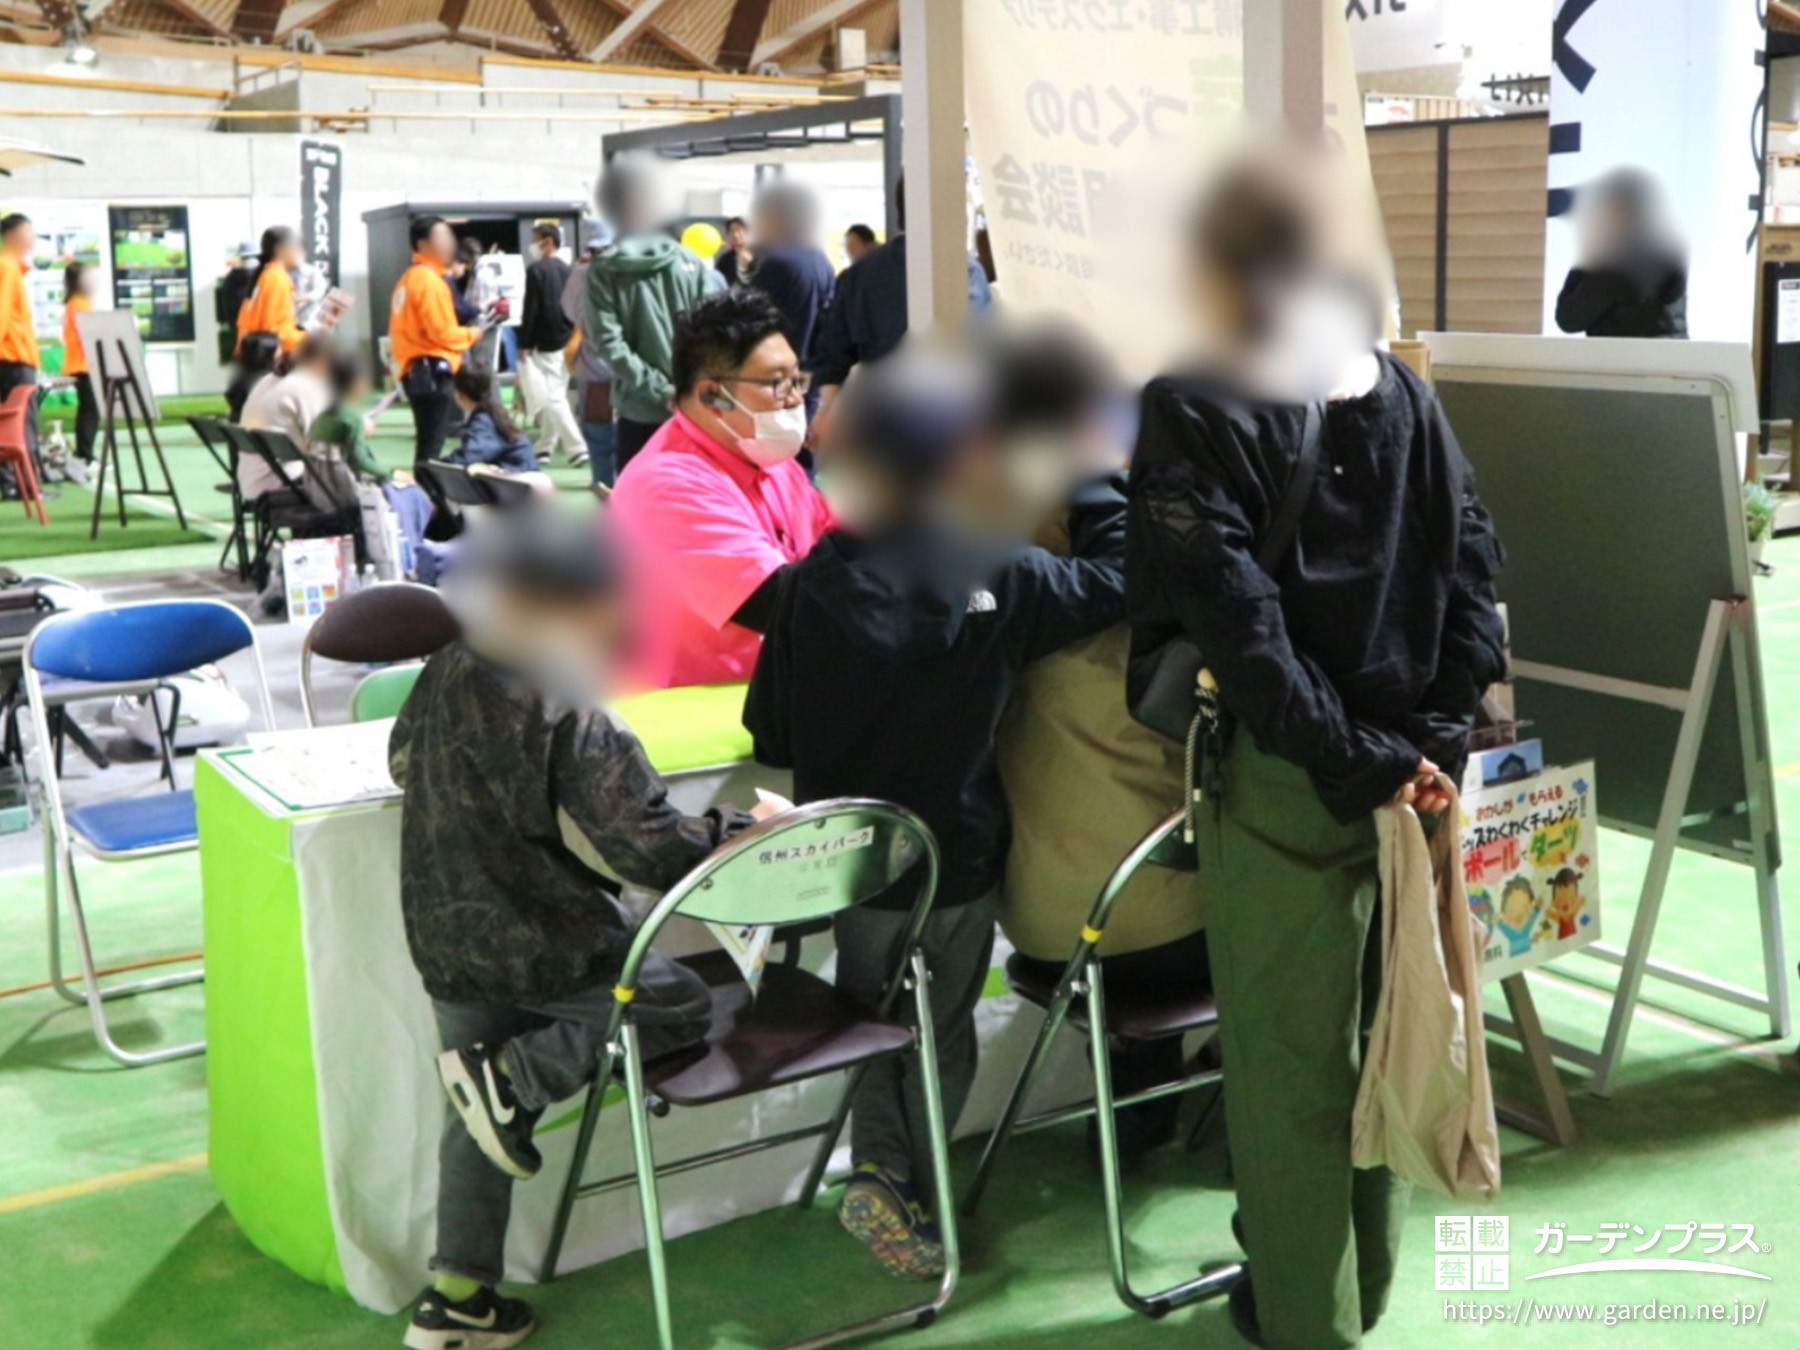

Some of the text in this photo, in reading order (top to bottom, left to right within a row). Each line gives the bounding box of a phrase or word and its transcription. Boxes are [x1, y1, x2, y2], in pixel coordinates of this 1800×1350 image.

[759, 831, 870, 864] 信州スカイパーク
